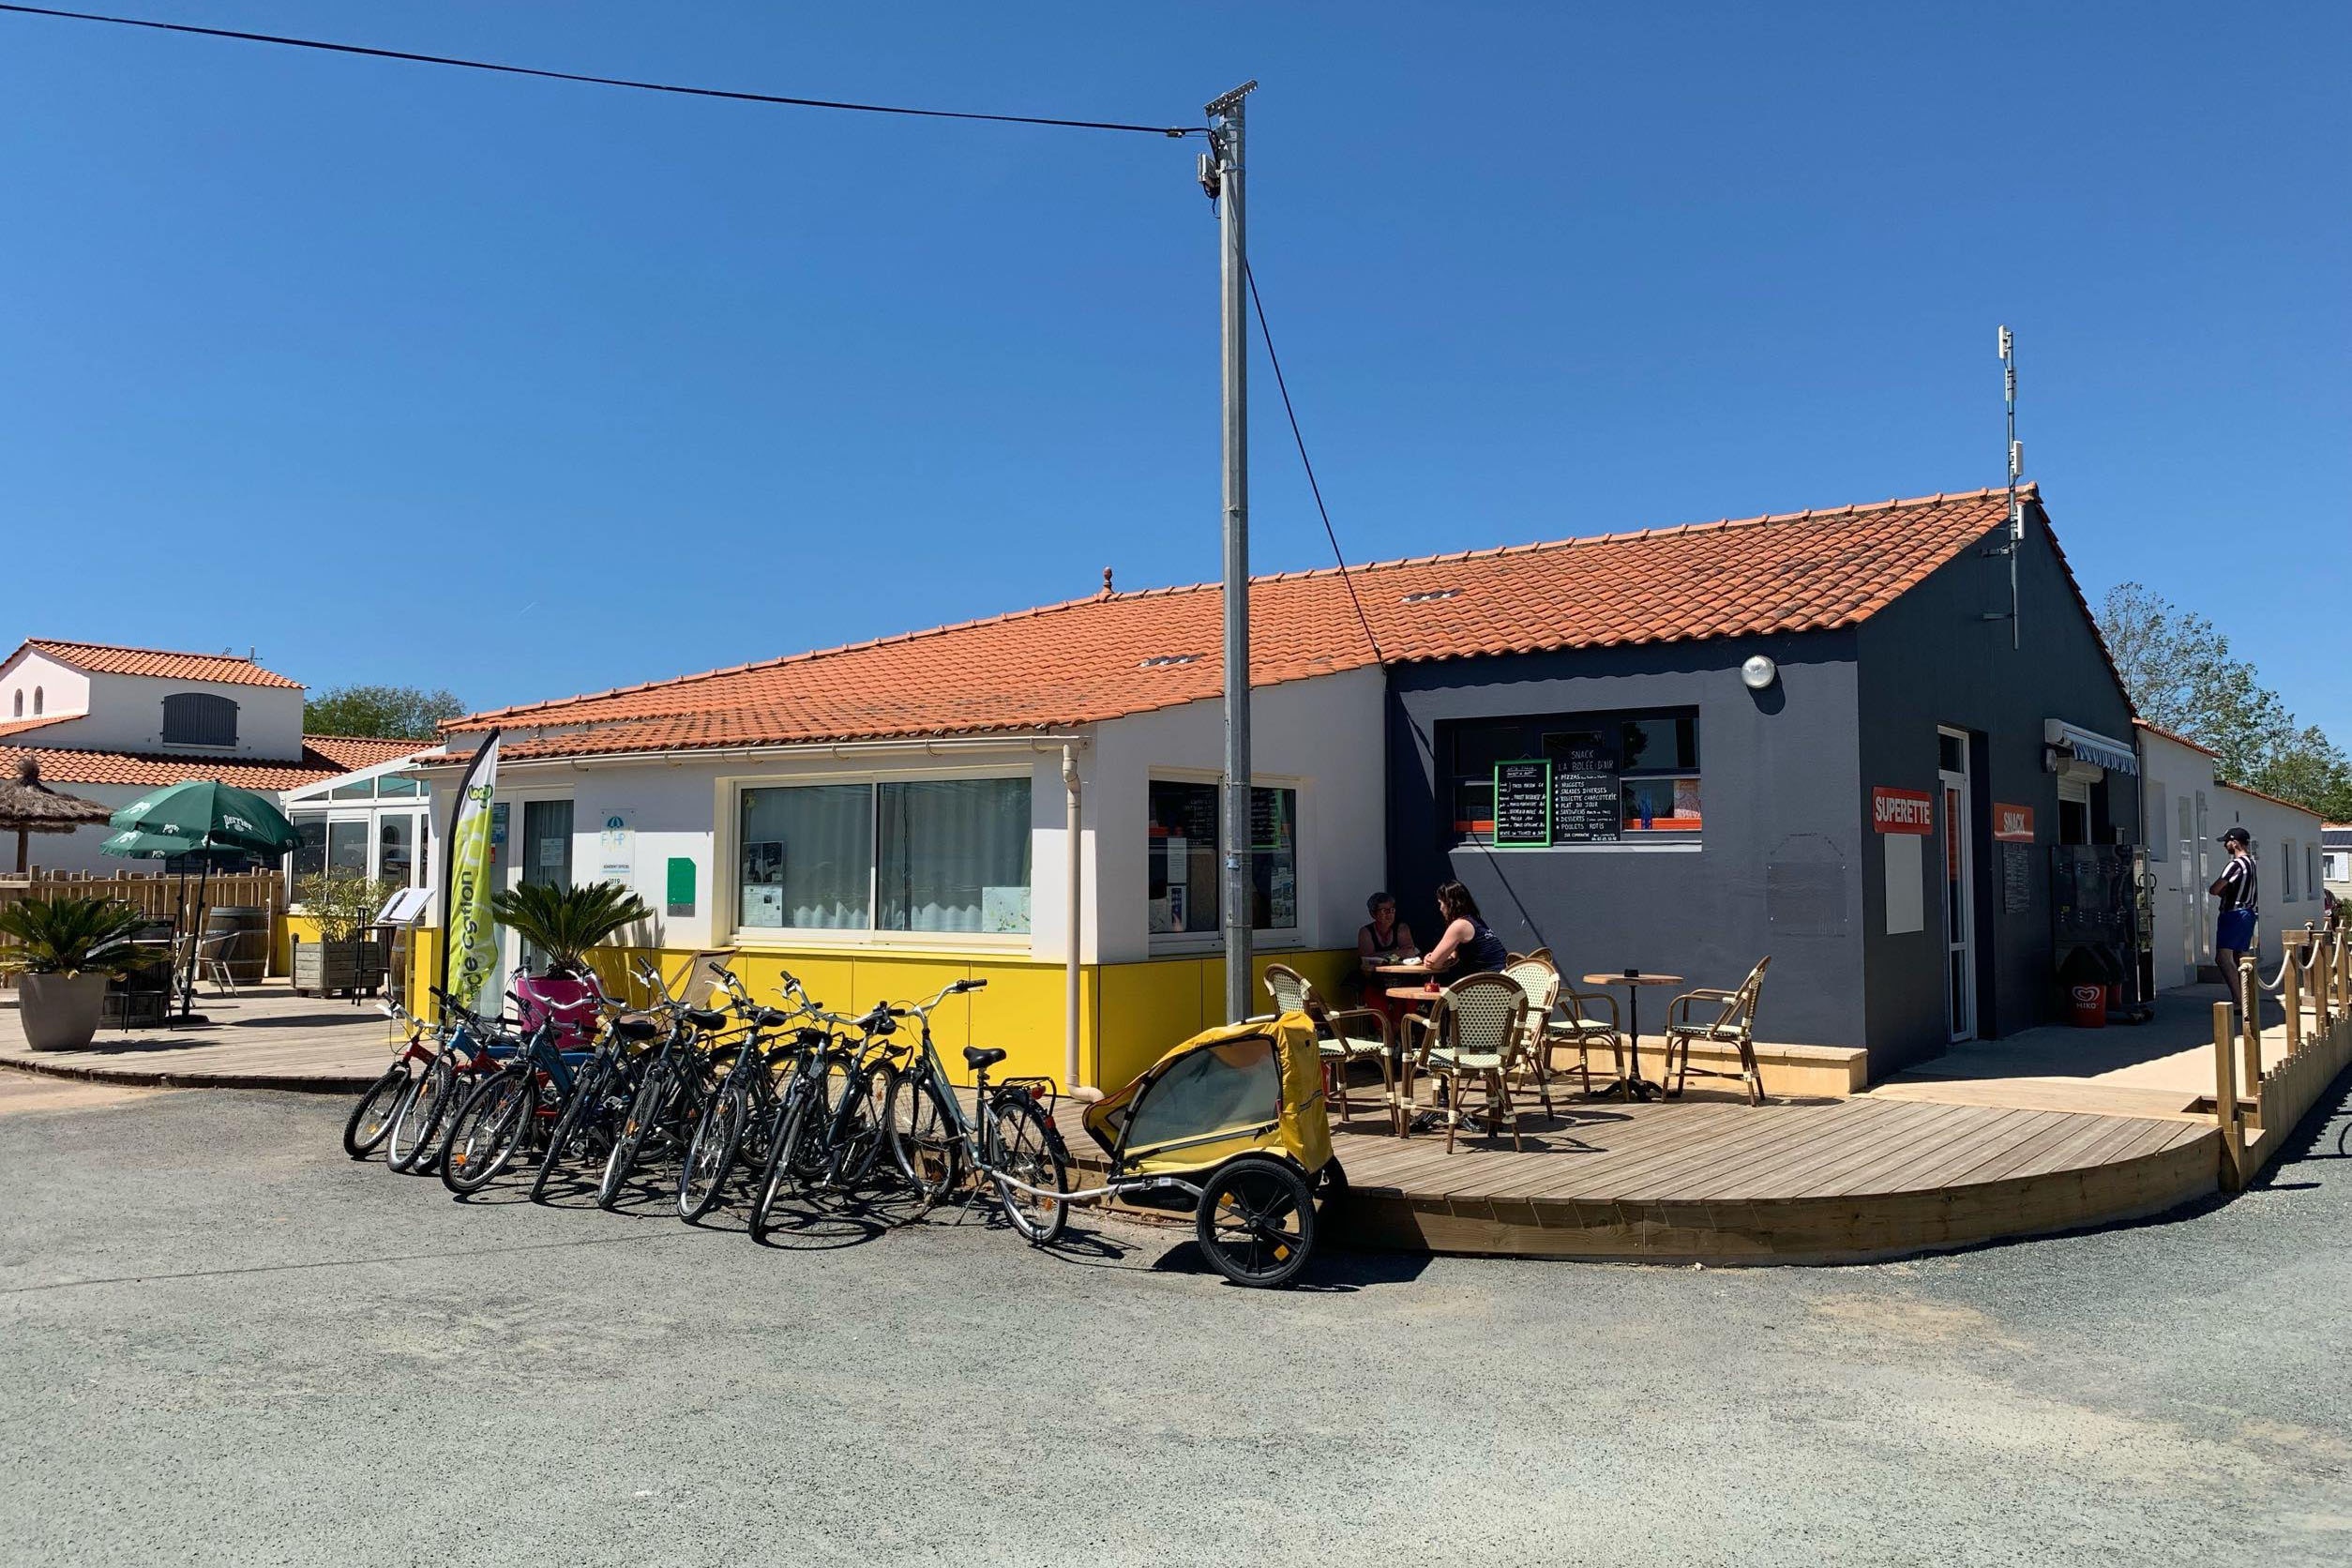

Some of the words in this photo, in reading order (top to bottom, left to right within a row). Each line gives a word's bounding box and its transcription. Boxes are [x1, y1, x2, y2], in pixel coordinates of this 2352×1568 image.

[1571, 749, 1595, 760] SNACK
[1876, 796, 1930, 825] SUPERETTE
[2003, 811, 2025, 834] SNACK
